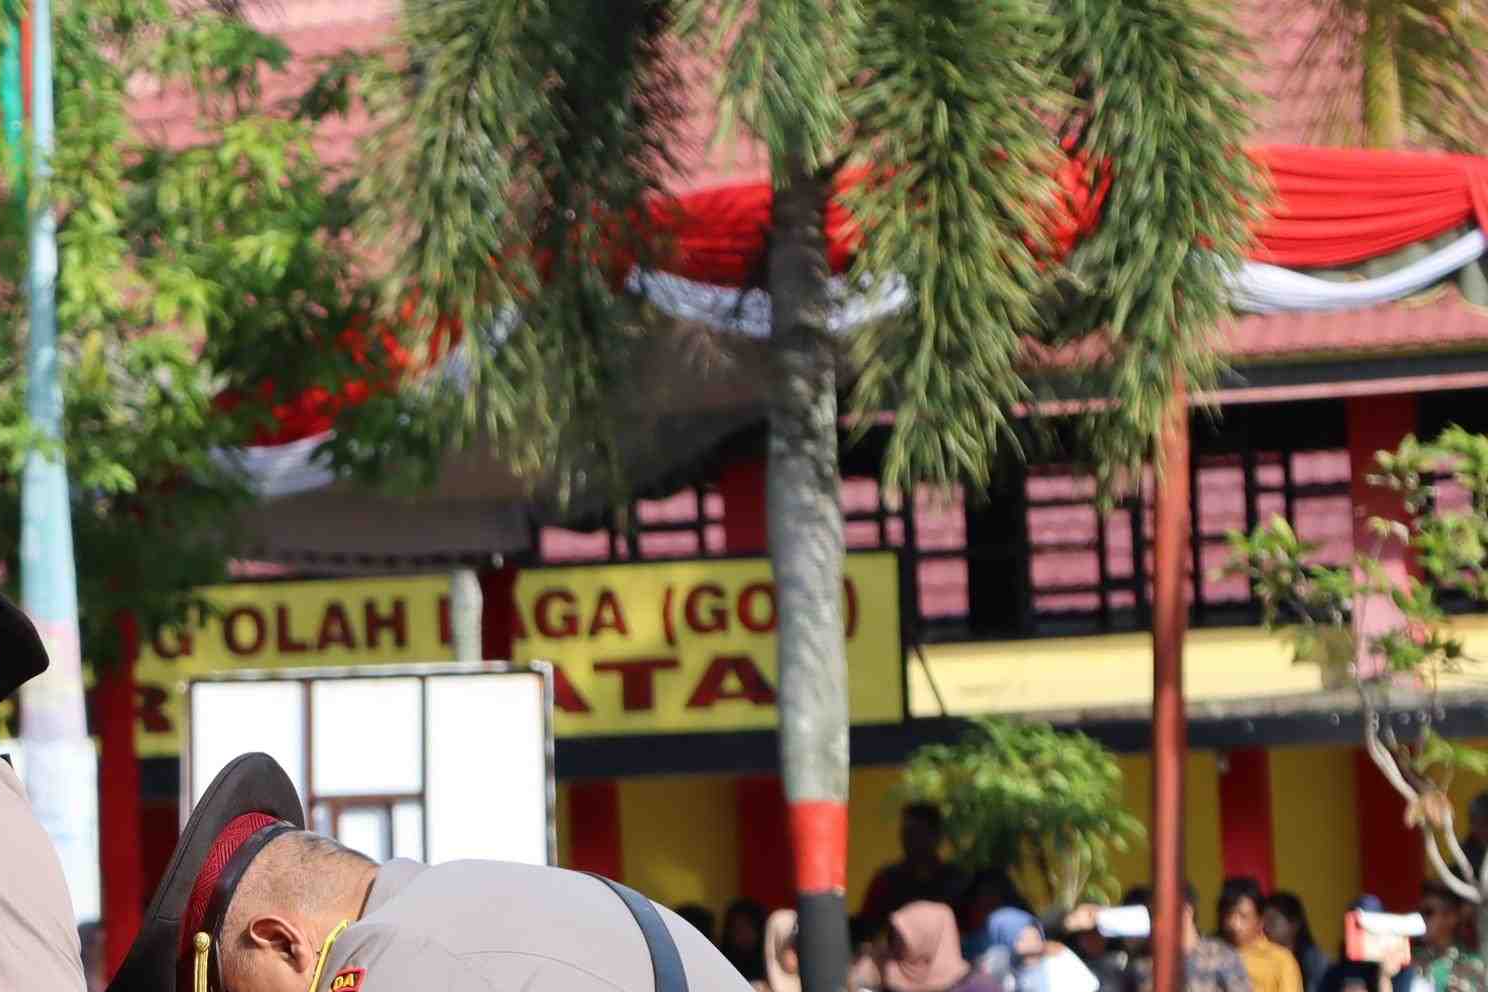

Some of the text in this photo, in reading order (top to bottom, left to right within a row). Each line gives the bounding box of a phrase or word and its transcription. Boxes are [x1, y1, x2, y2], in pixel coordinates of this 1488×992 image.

[223, 597, 409, 656] OLAH
[438, 587, 629, 649] GA
[662, 575, 861, 647] (GO)
